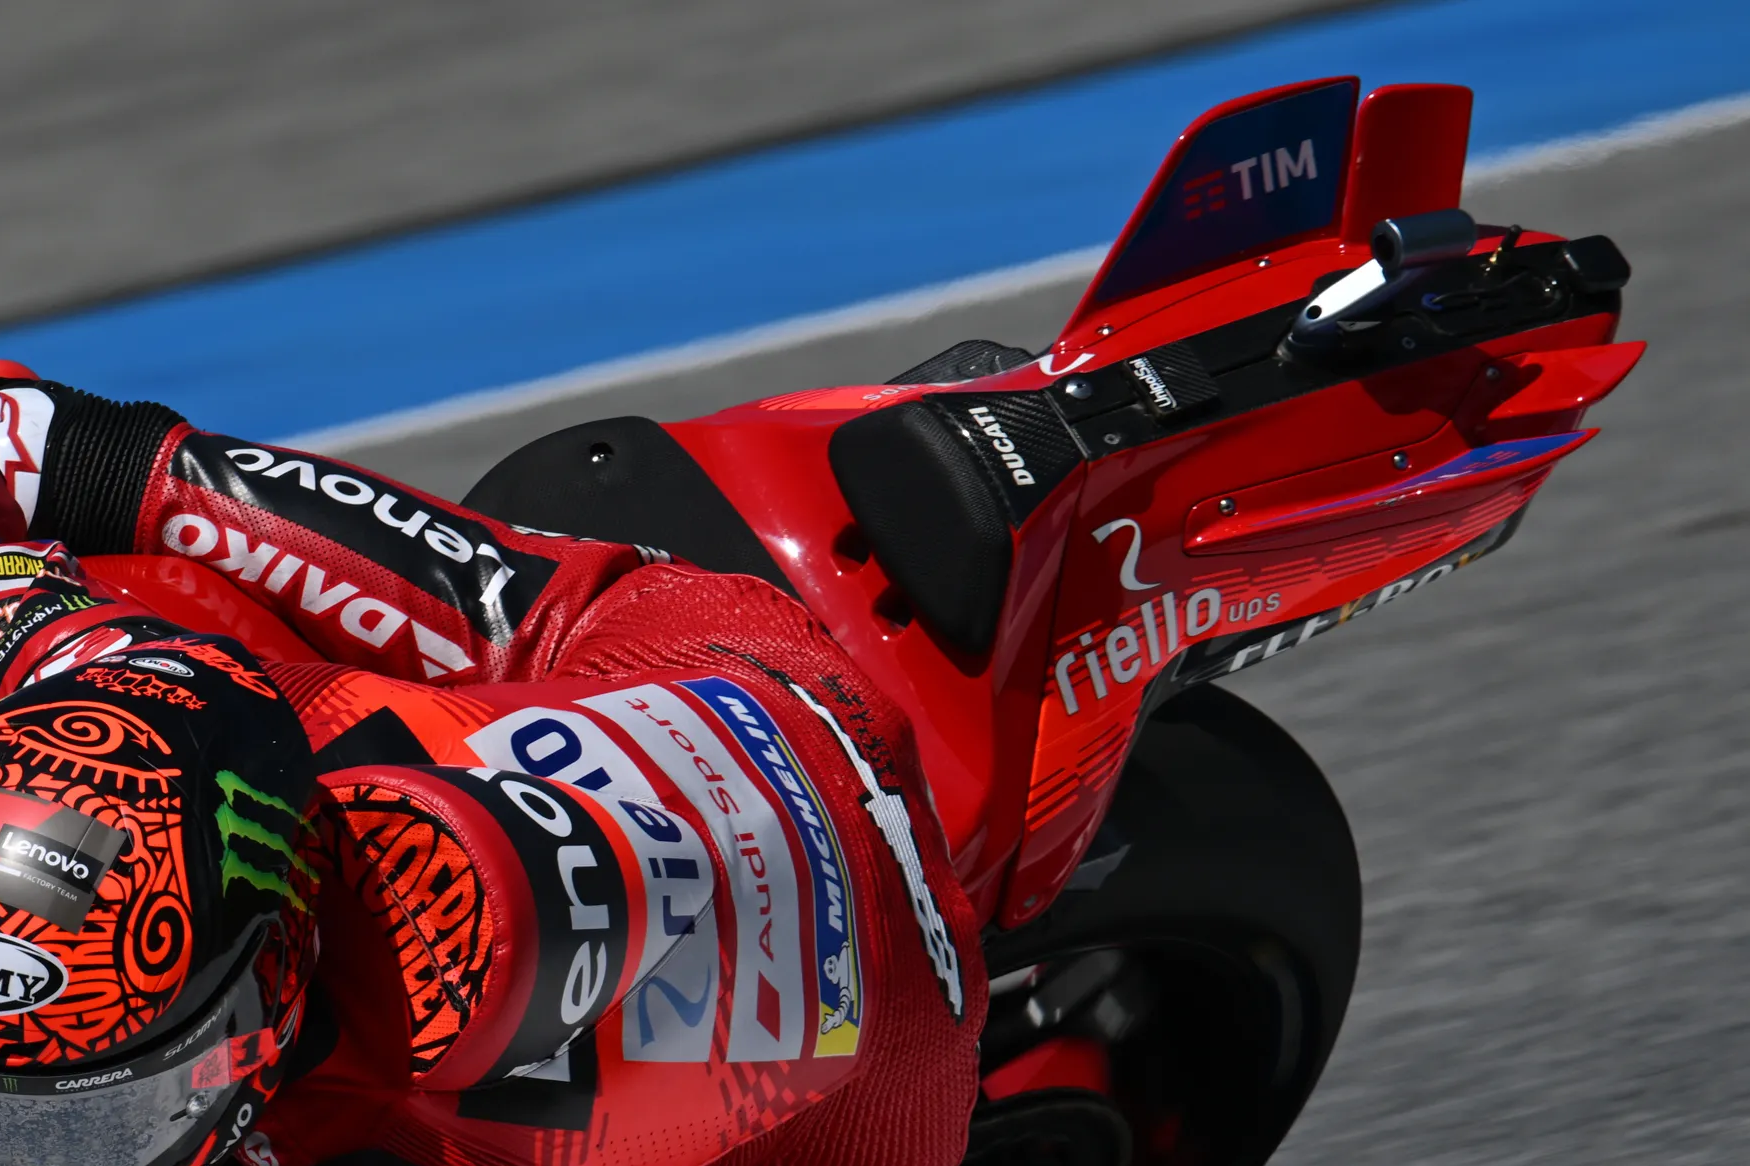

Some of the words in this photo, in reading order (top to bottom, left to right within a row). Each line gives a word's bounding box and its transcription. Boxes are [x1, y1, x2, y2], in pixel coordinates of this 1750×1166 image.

[1231, 139, 1318, 201] TIM
[968, 406, 1035, 486] DUCATI
[225, 447, 516, 604] Lenovo
[1055, 587, 1221, 714] riello
[1229, 592, 1281, 624] ups
[623, 697, 740, 815] Sport
[718, 694, 848, 933] MICHELIN
[2, 831, 90, 881] Lenovo
[23, 872, 55, 891] FACTORY
[57, 886, 78, 902] TEAM
[737, 831, 772, 959] Audi
[162, 1007, 222, 1061] SUOMY
[55, 1067, 134, 1091] CARRERA
